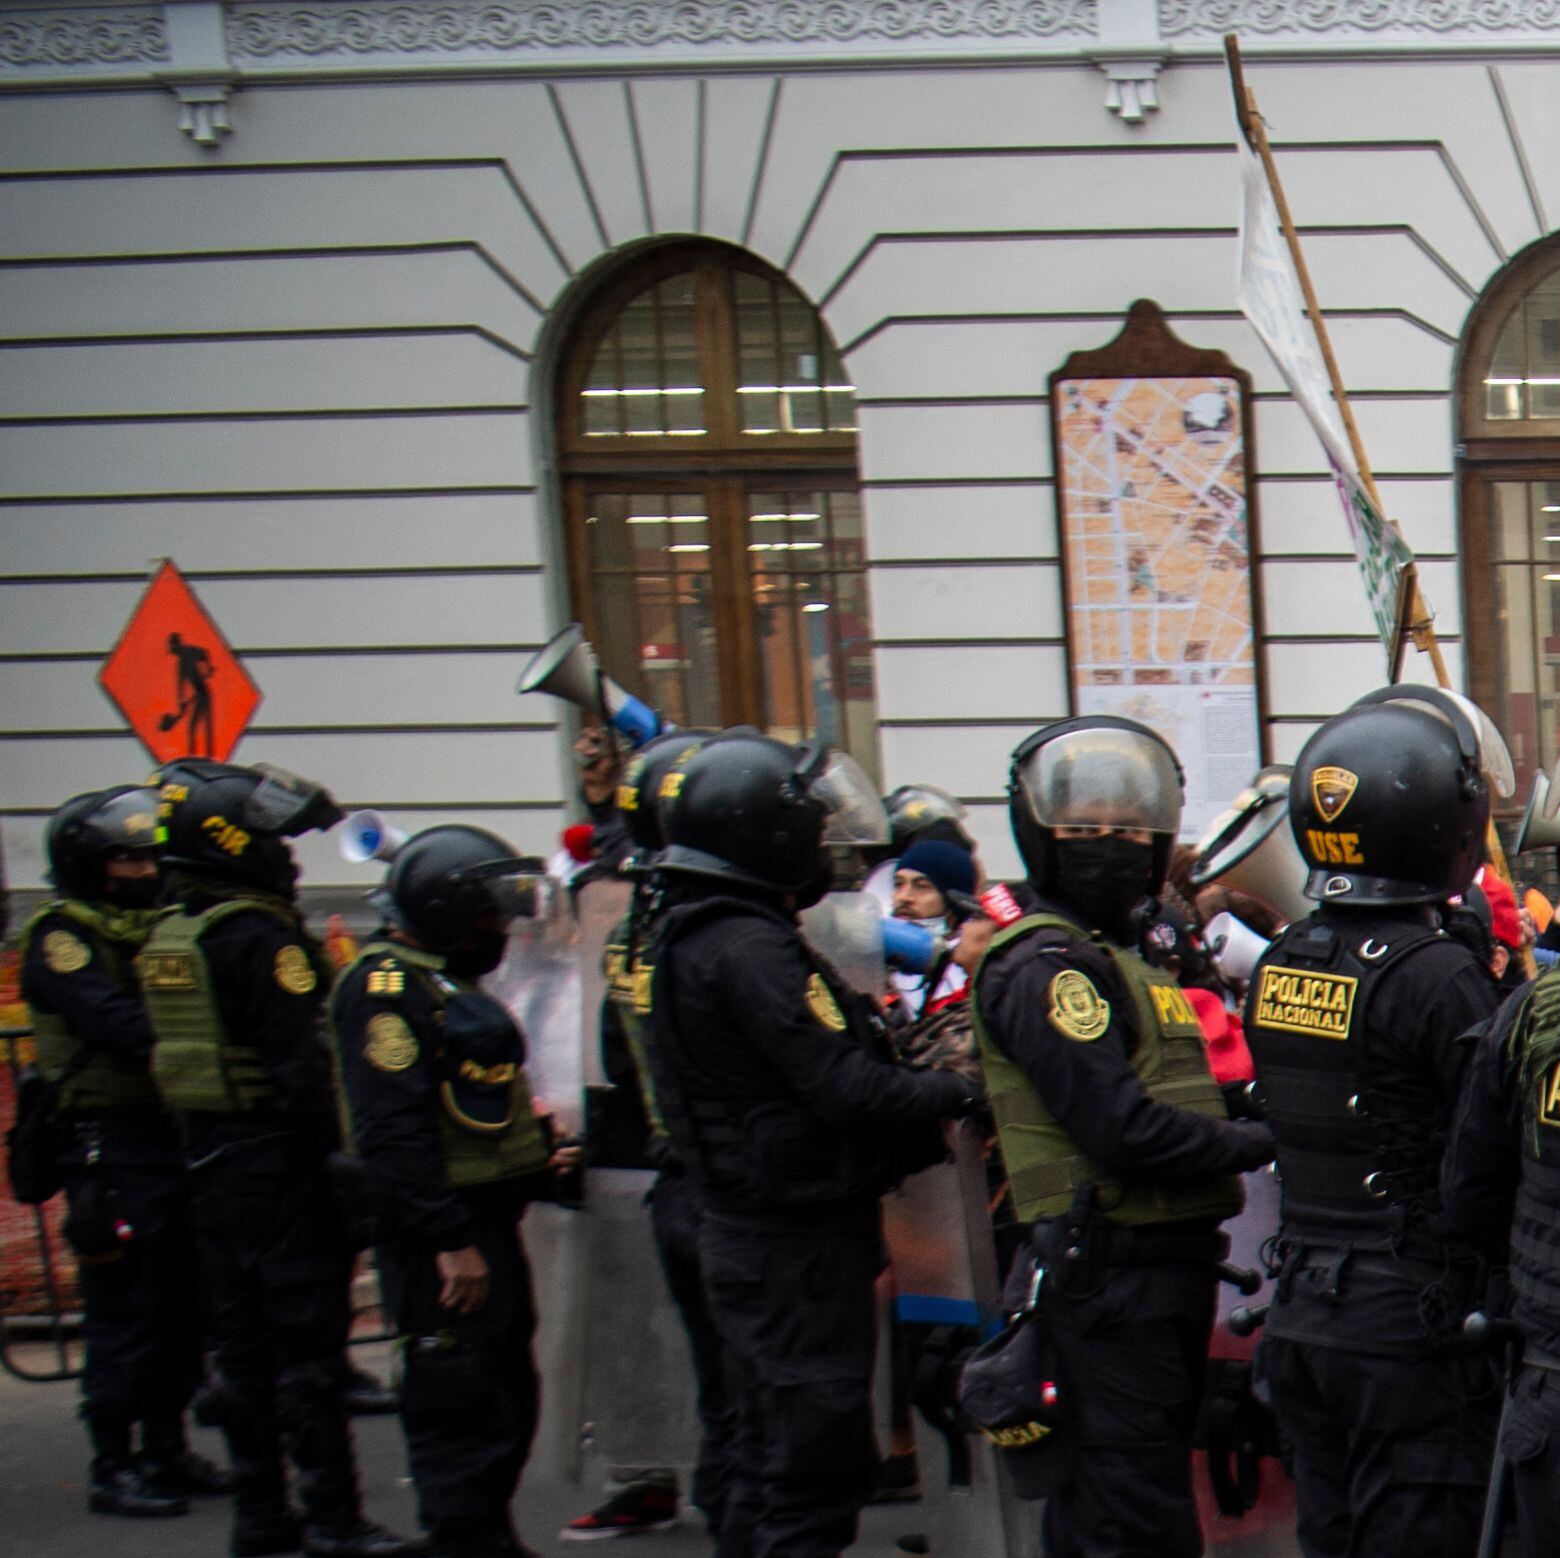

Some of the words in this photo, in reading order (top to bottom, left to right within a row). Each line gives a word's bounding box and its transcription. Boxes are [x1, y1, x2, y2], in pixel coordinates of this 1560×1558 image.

[1306, 829, 1364, 866] USE
[1264, 974, 1348, 1012] POLICIA
[1261, 1001, 1346, 1031] NACIONAL
